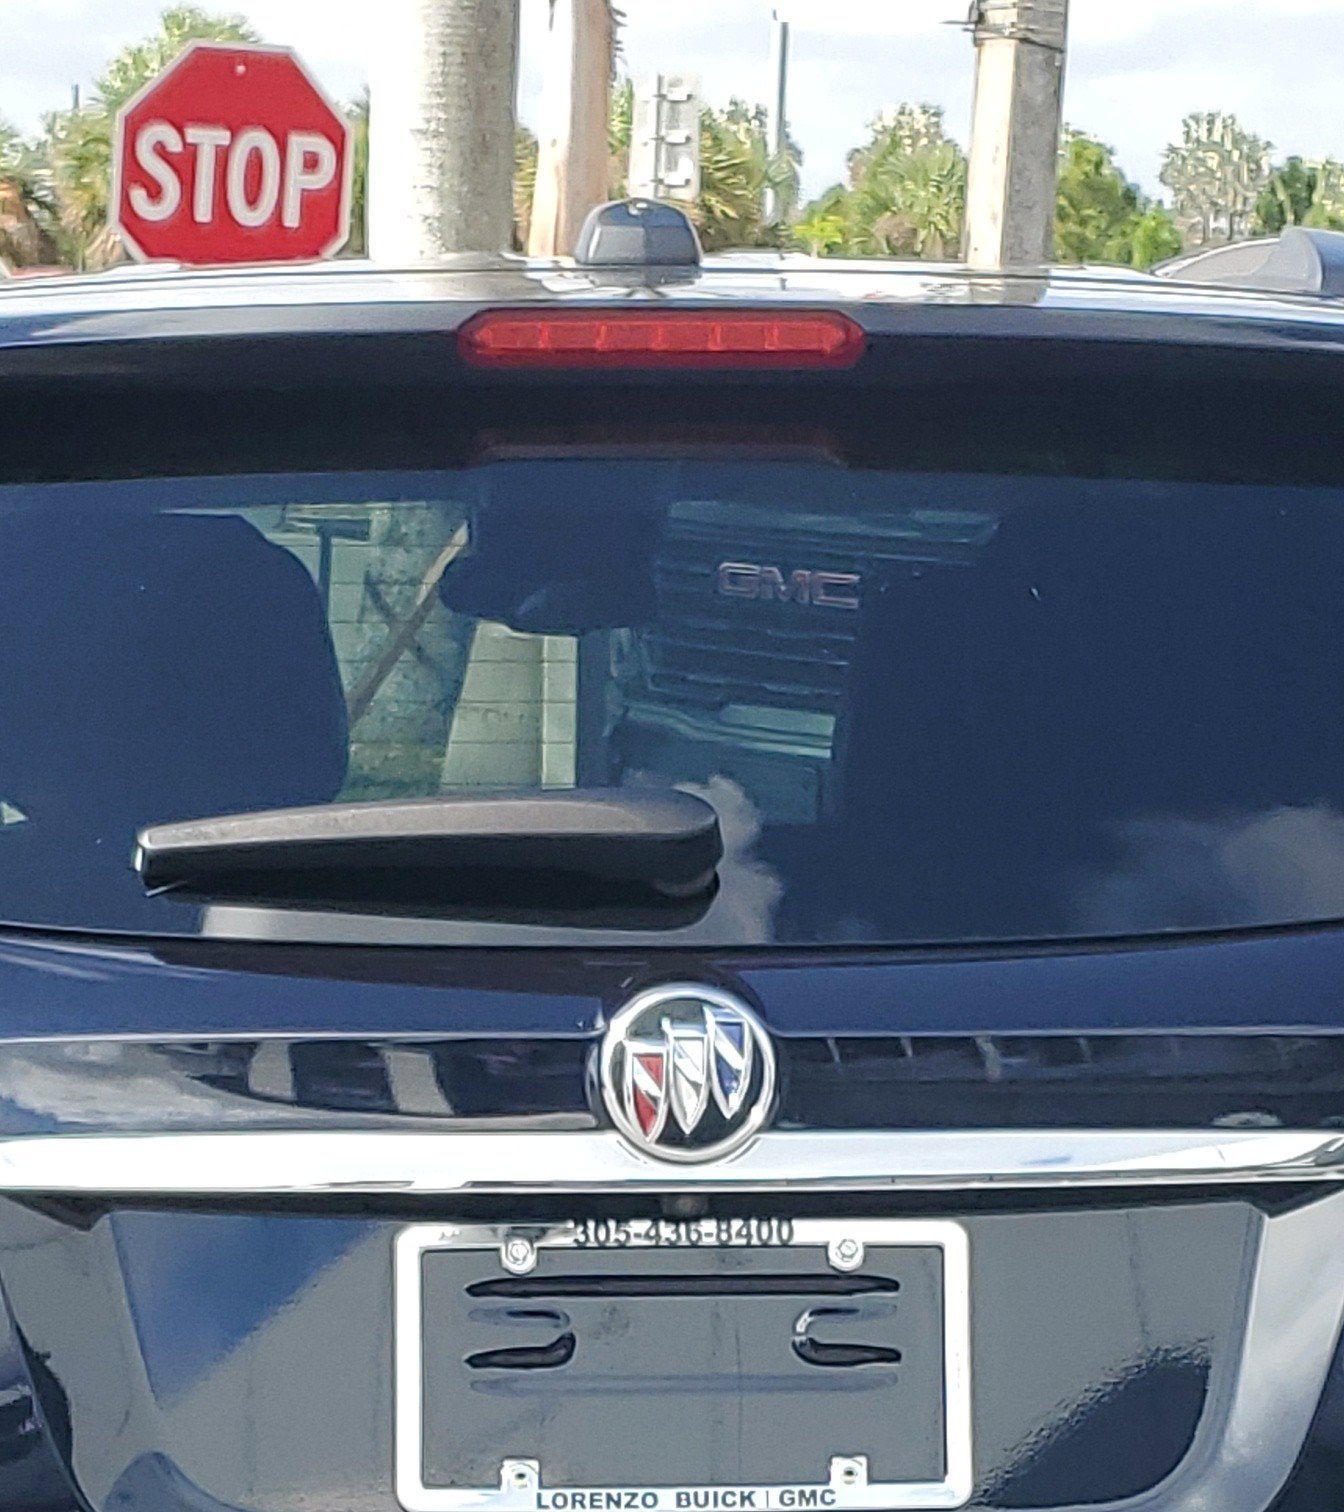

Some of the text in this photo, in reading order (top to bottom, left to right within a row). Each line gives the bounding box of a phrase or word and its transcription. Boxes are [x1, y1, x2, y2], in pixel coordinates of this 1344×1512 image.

[128, 121, 337, 229] STOP
[717, 561, 861, 609] GMC
[573, 1218, 794, 1246] 305-436-8400
[535, 1488, 838, 1511] LORENZO BUICK GMC
